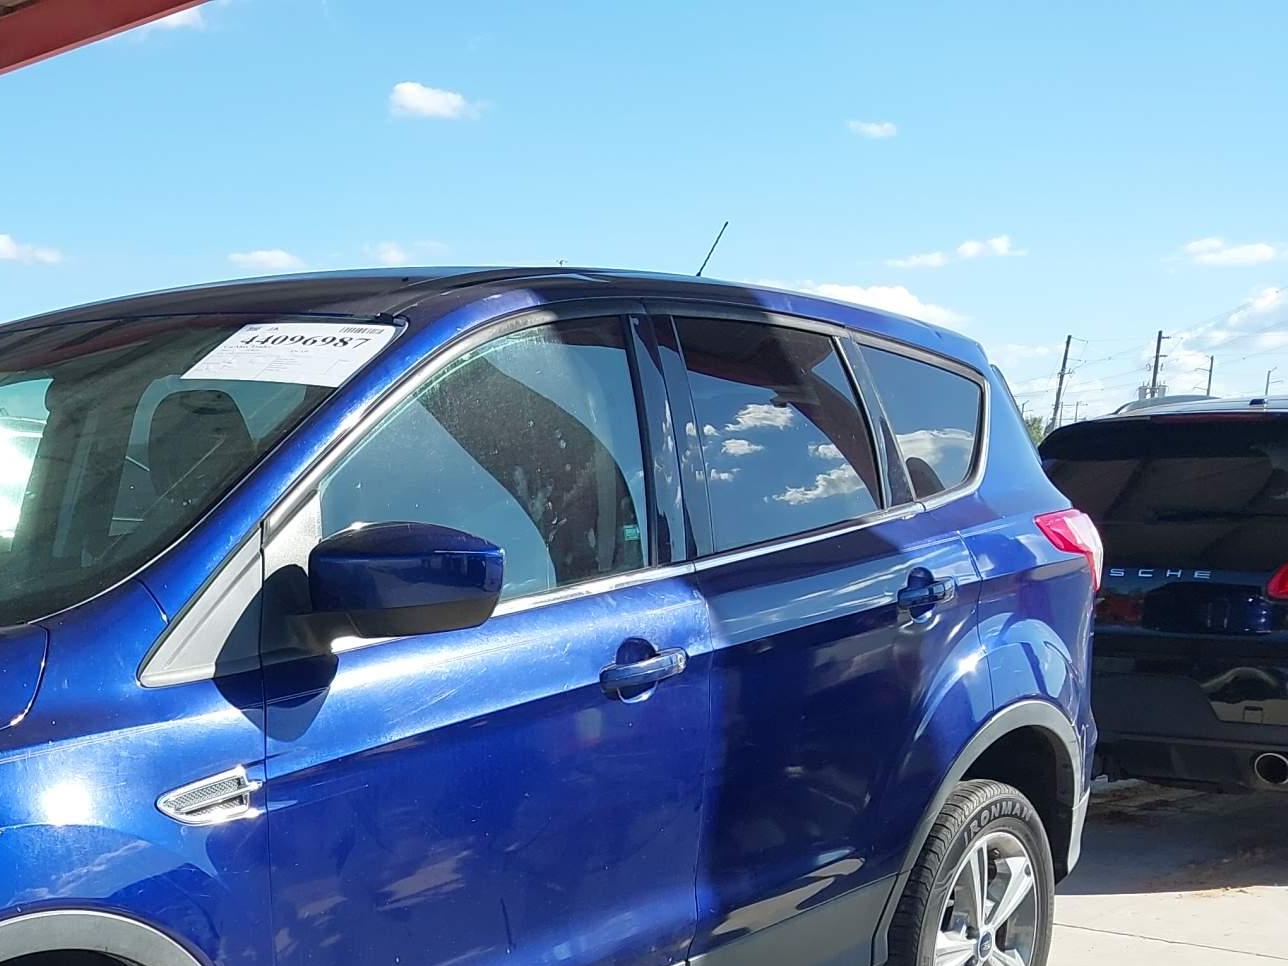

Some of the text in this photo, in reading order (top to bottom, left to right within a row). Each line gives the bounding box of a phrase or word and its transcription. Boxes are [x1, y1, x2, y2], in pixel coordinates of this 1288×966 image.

[240, 334, 372, 349] 44096987
[1109, 568, 1212, 580] SCHE
[964, 801, 1034, 846] IRONMAN
